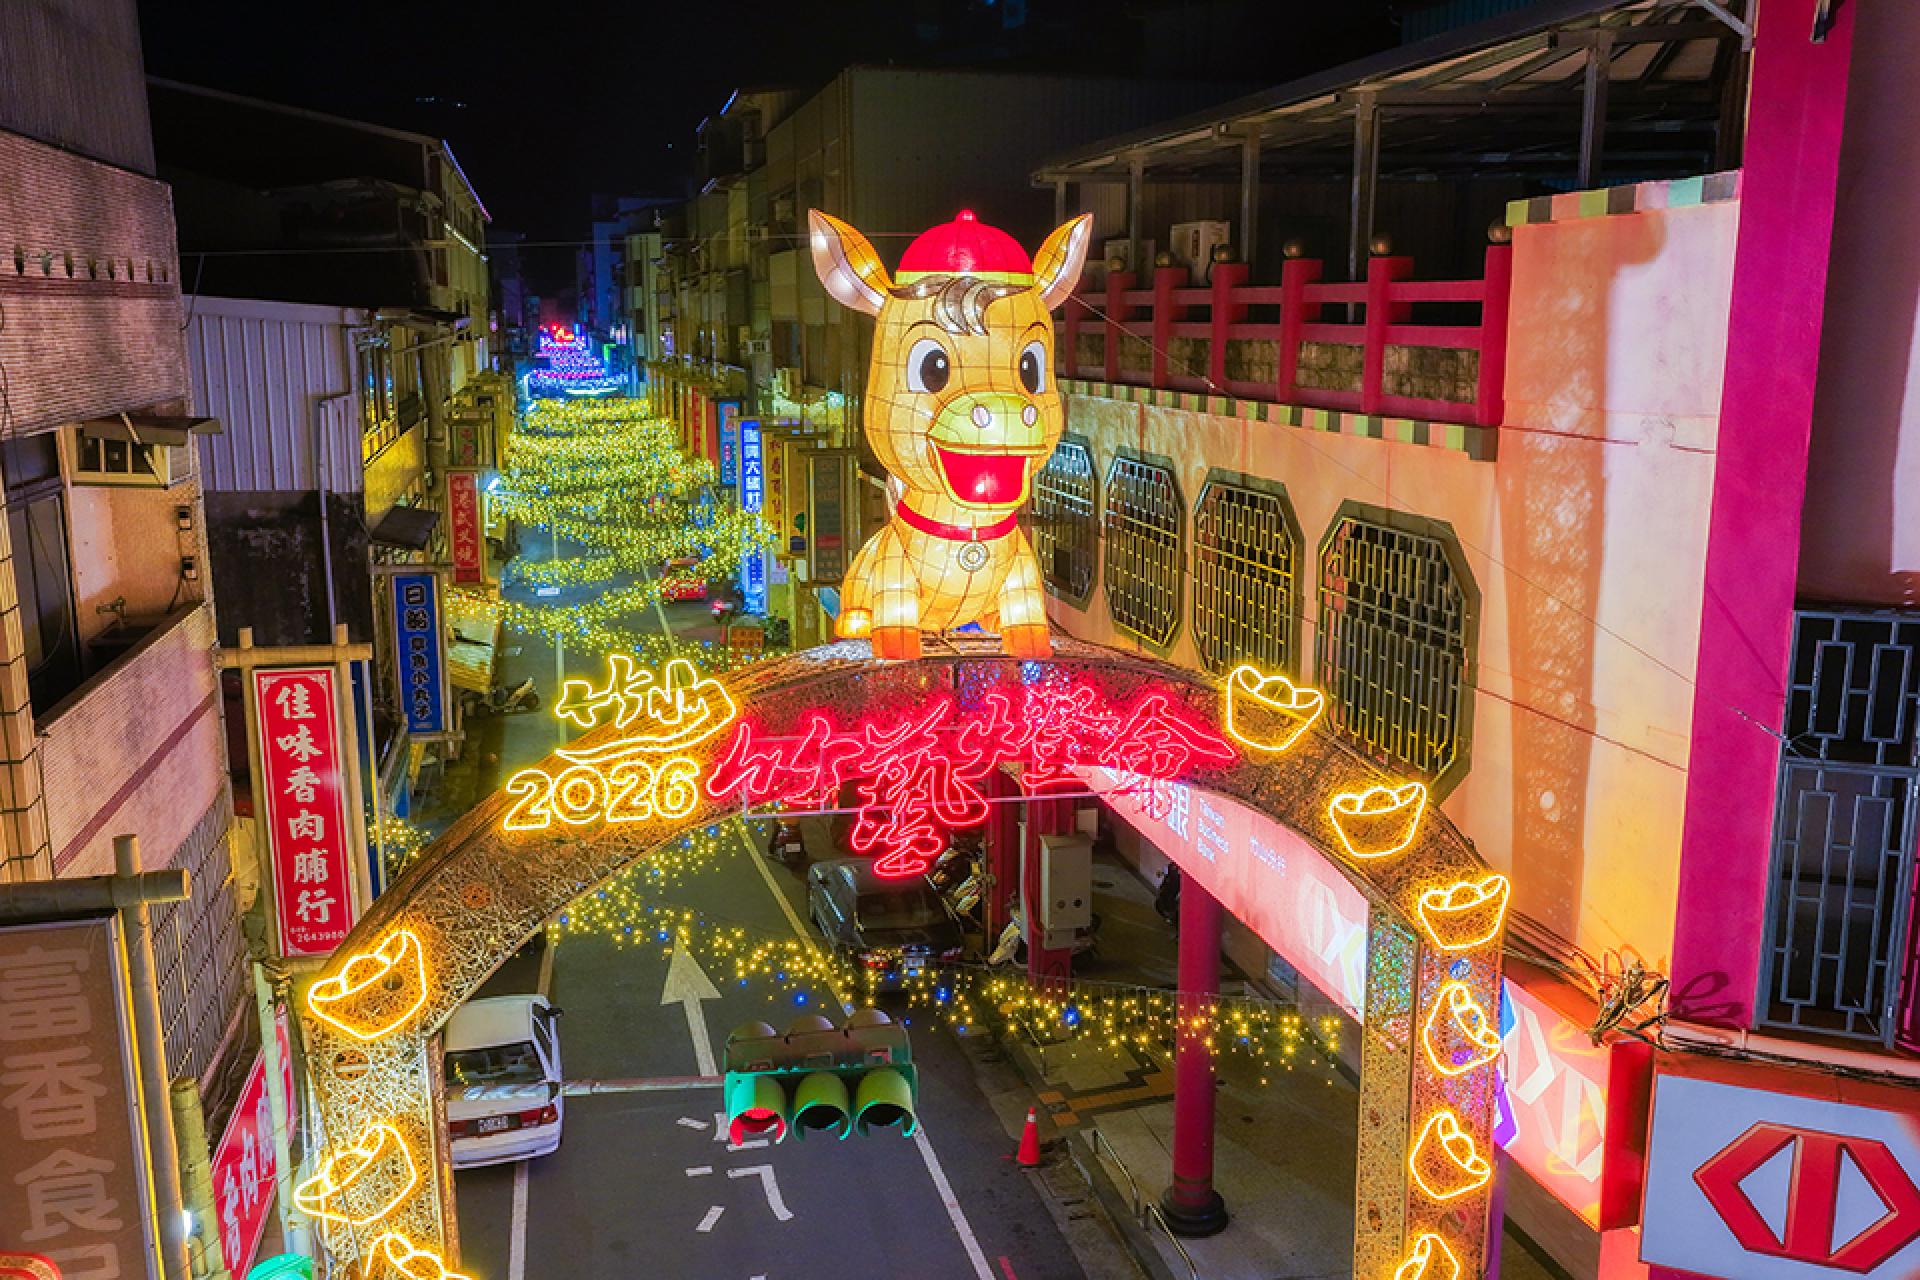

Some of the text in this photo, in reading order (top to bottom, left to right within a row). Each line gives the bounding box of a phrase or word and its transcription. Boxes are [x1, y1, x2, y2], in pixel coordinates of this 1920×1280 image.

[275, 683, 336, 923] 佳味香肉脯行
[503, 757, 702, 831] 2026
